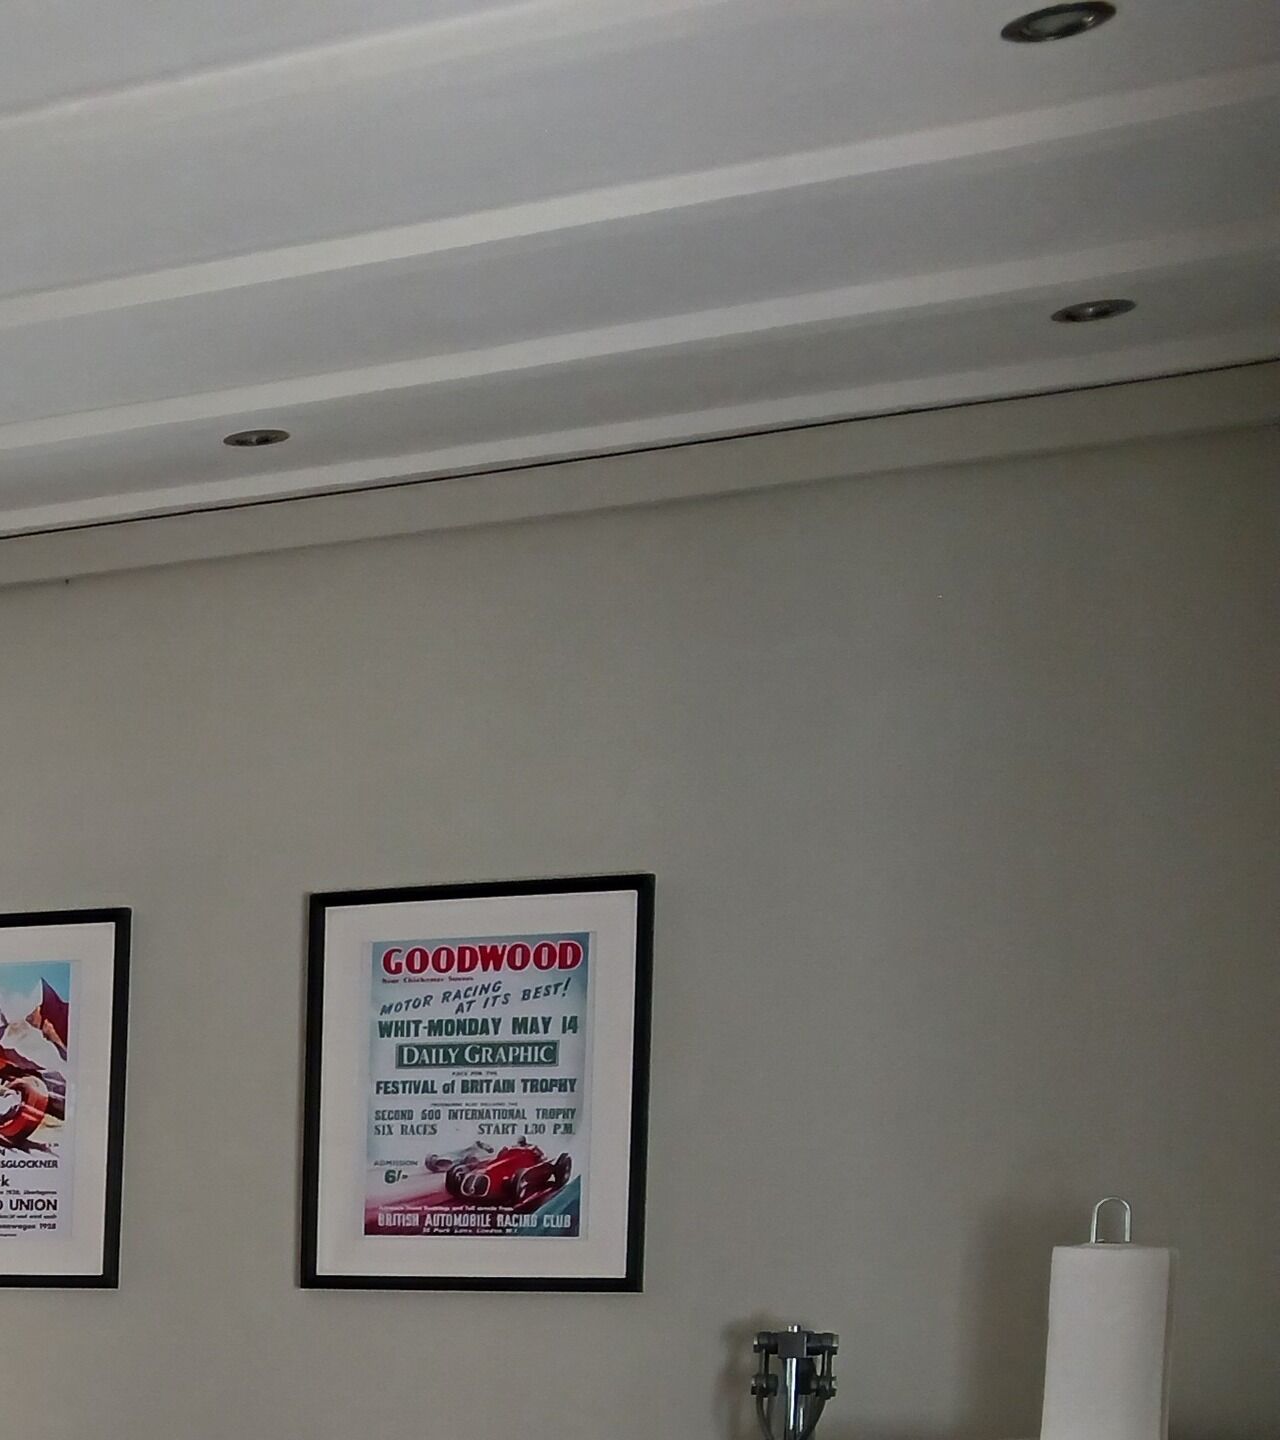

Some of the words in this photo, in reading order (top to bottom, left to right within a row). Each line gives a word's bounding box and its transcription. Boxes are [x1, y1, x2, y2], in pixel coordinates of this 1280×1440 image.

[382, 941, 583, 975] GOODWOOD
[379, 994, 433, 1016] MOTOR
[441, 980, 503, 1004] RACING
[455, 1000, 476, 1015] AT
[482, 993, 512, 1009] ITS
[521, 977, 572, 1003] BEST!
[378, 1017, 502, 1038] WHIT-MONDAY
[511, 1016, 552, 1036] MAY
[561, 1015, 579, 1034] 14
[402, 1046, 460, 1065] DAILY
[464, 1044, 554, 1064] GRAPHIC
[375, 1080, 437, 1095] FESTIVAL
[442, 1079, 455, 1094] of
[461, 1079, 516, 1094] BRITAIN
[520, 1078, 577, 1094] TROPHY
[374, 1109, 414, 1121] SECOND
[448, 1108, 527, 1121] INTERNATIONAL
[536, 1107, 577, 1120] TROPHY
[374, 1124, 394, 1136] SIX
[400, 1124, 438, 1136] RACES
[477, 1123, 517, 1135] START
[9, 1198, 57, 1211] UNION
[377, 1213, 419, 1227] BRITISH
[425, 1213, 491, 1228] AUTOMOBILE
[497, 1213, 538, 1227] RACING
[543, 1214, 572, 1228] CLUB
